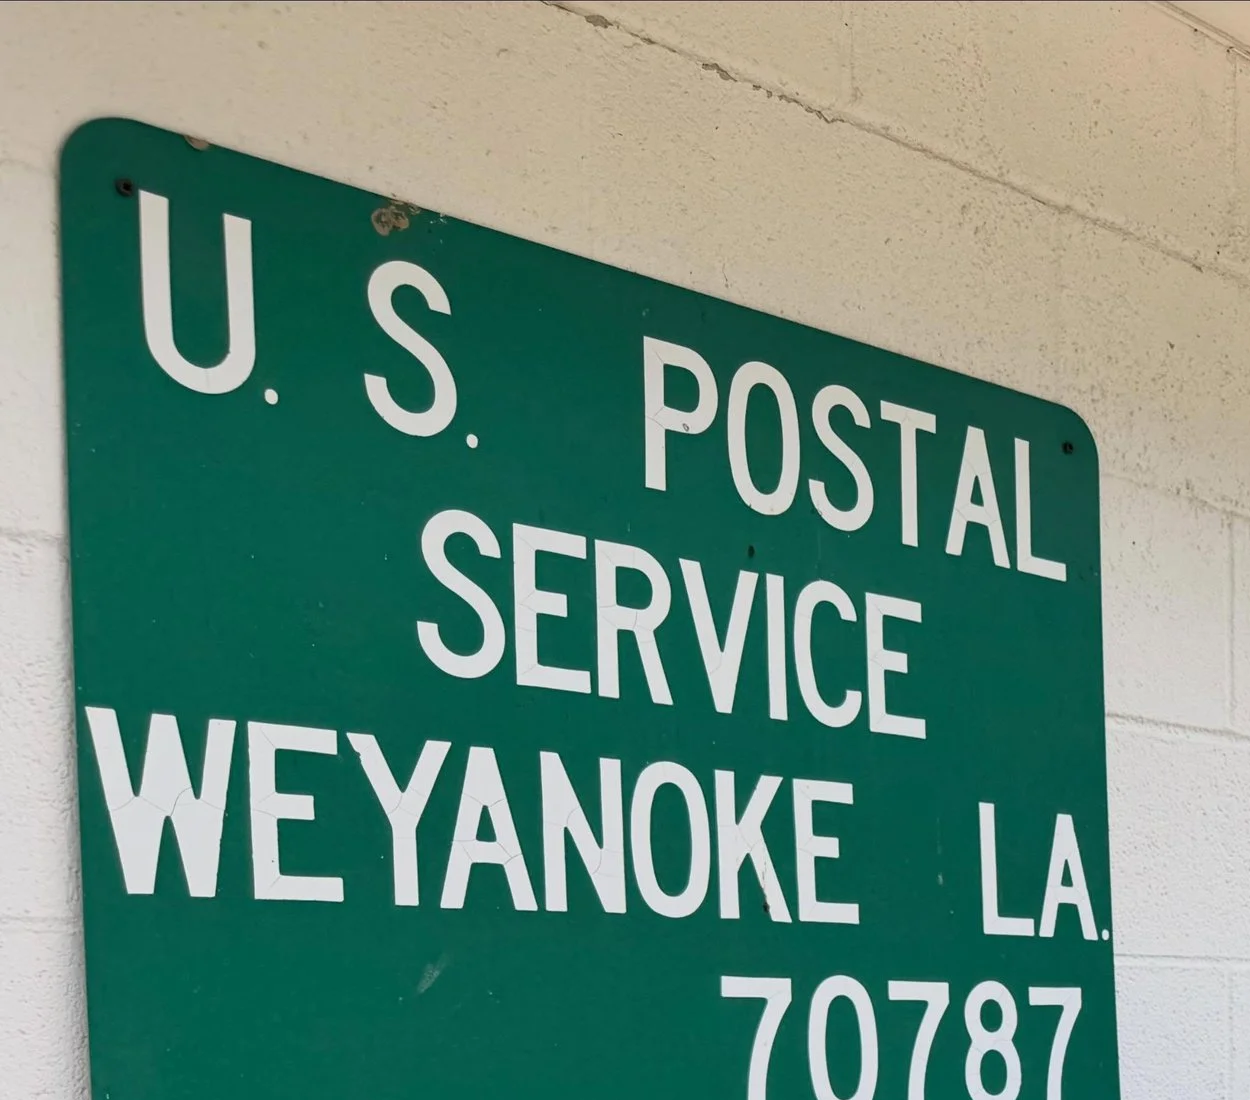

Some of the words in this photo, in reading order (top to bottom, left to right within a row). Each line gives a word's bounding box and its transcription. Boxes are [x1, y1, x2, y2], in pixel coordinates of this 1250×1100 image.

[139, 190, 280, 405] U.
[364, 260, 480, 449] S.
[643, 335, 1067, 582] POSTAL
[416, 508, 928, 740] SERVICE
[84, 706, 861, 925] WEYANOKE
[979, 802, 1112, 942] LA.
